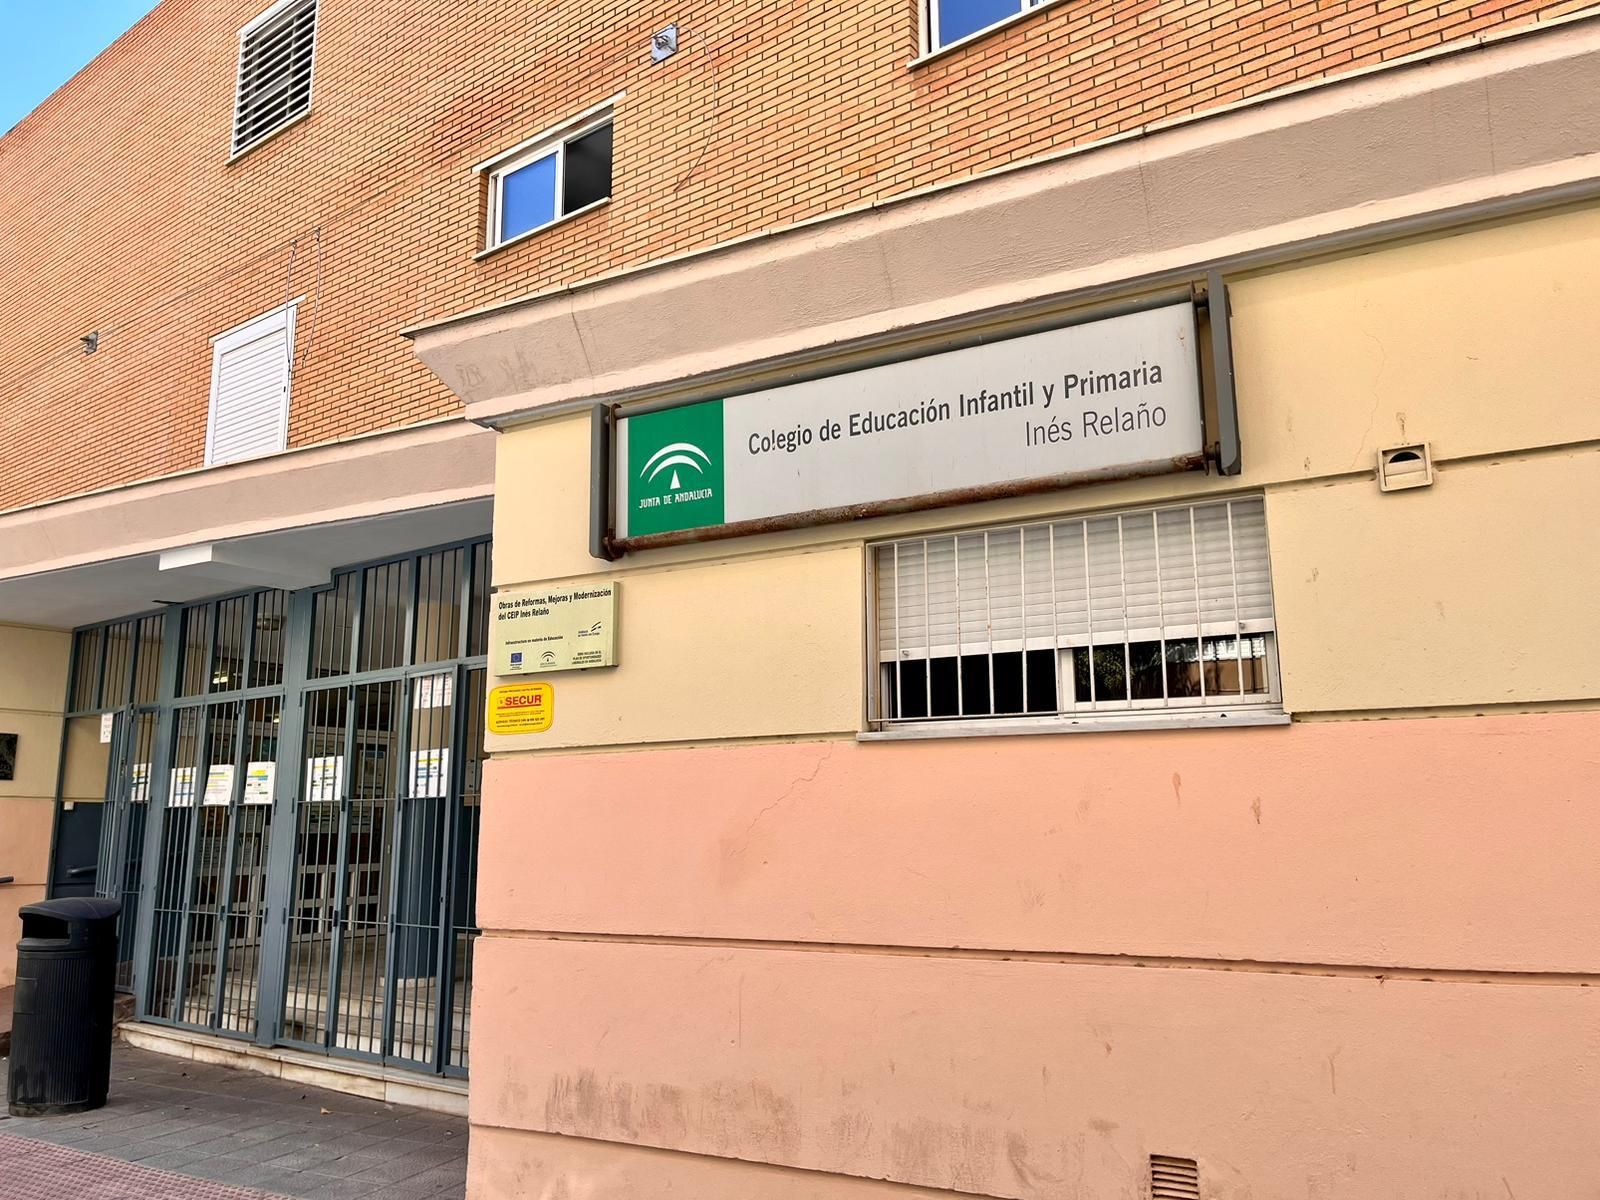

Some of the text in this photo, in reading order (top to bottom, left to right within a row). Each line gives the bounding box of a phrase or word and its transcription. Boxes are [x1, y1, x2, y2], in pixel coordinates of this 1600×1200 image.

[748, 361, 1163, 455] Colegio de Educación Infantil y Primaria
[1025, 402, 1167, 446] Inés Relaño
[638, 496, 661, 509] JUNTA
[663, 494, 673, 505] DE
[498, 588, 612, 610] Obras de Reformas, Mejoras y Modernización
[498, 613, 507, 621] del
[507, 611, 520, 620] CEIP
[505, 694, 542, 706] SECUR
